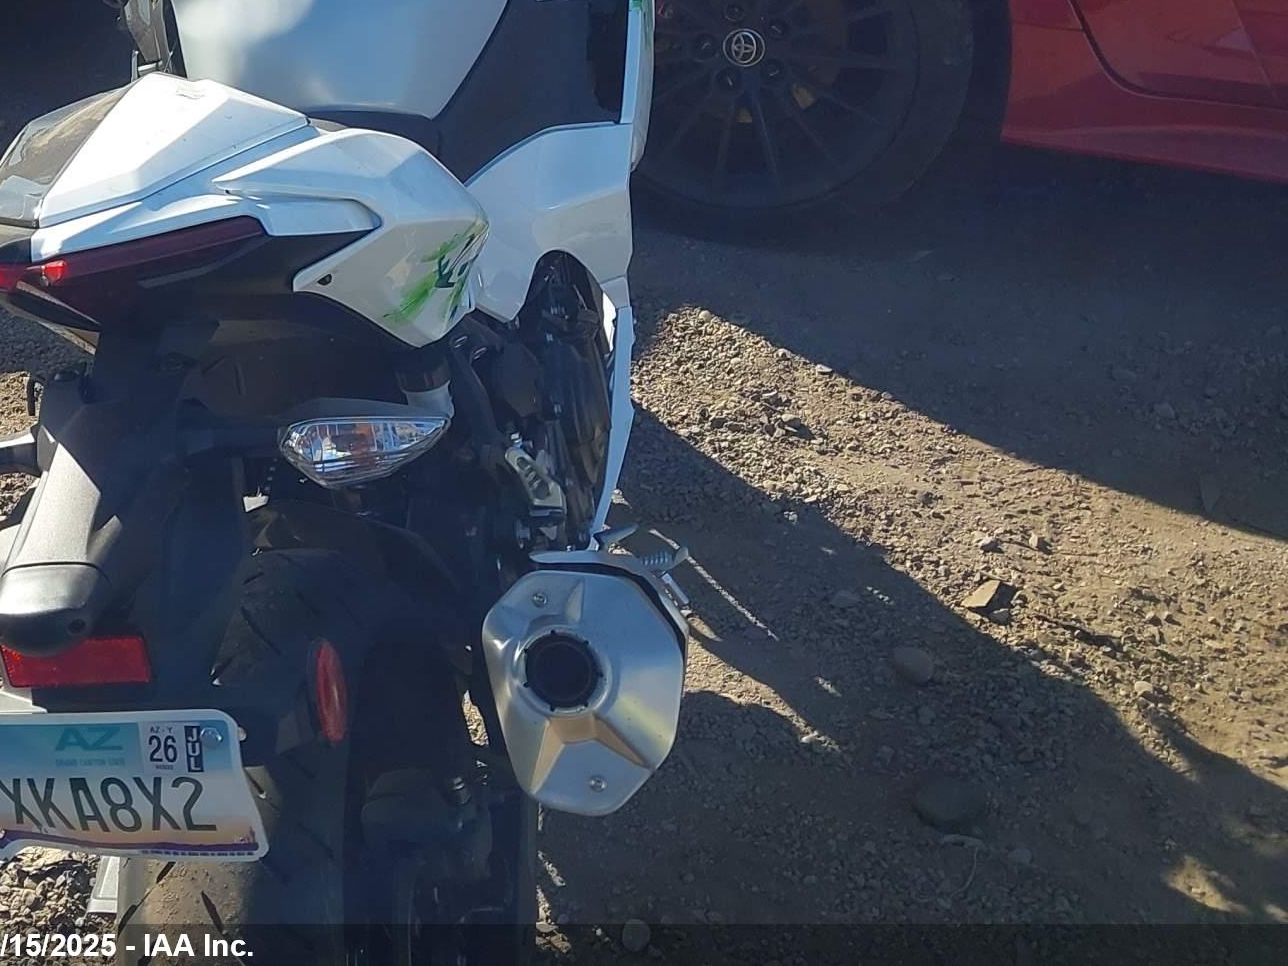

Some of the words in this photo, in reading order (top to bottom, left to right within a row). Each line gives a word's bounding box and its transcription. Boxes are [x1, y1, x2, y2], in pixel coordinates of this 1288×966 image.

[56, 726, 123, 751] AZ
[148, 735, 178, 763] 26
[187, 727, 202, 771] JUL
